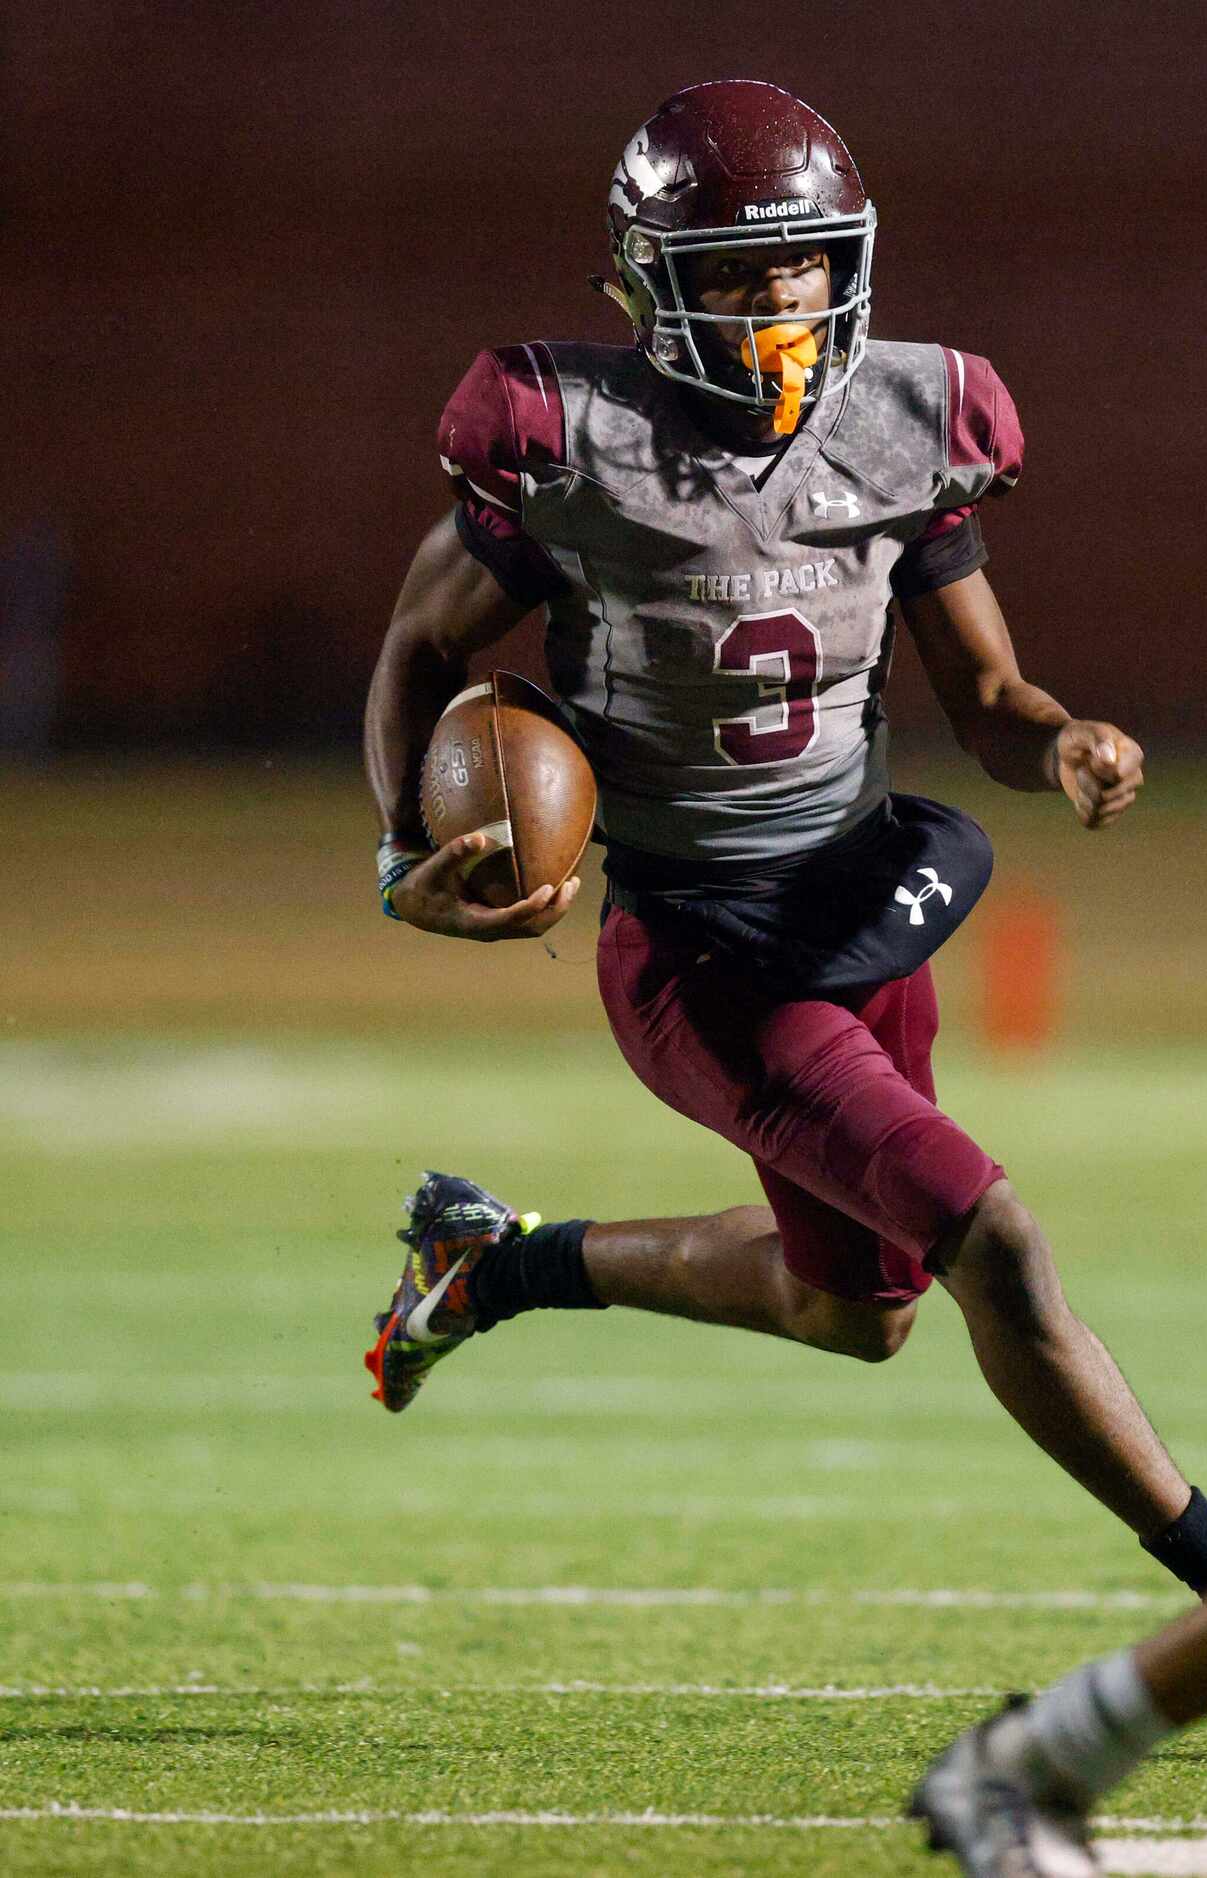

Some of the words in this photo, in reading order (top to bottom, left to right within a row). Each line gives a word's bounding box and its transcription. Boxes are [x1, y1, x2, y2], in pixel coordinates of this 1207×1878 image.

[744, 199, 811, 220] Riddell
[684, 574, 751, 601] THE
[763, 558, 839, 598] PACK
[712, 607, 824, 766] 3
